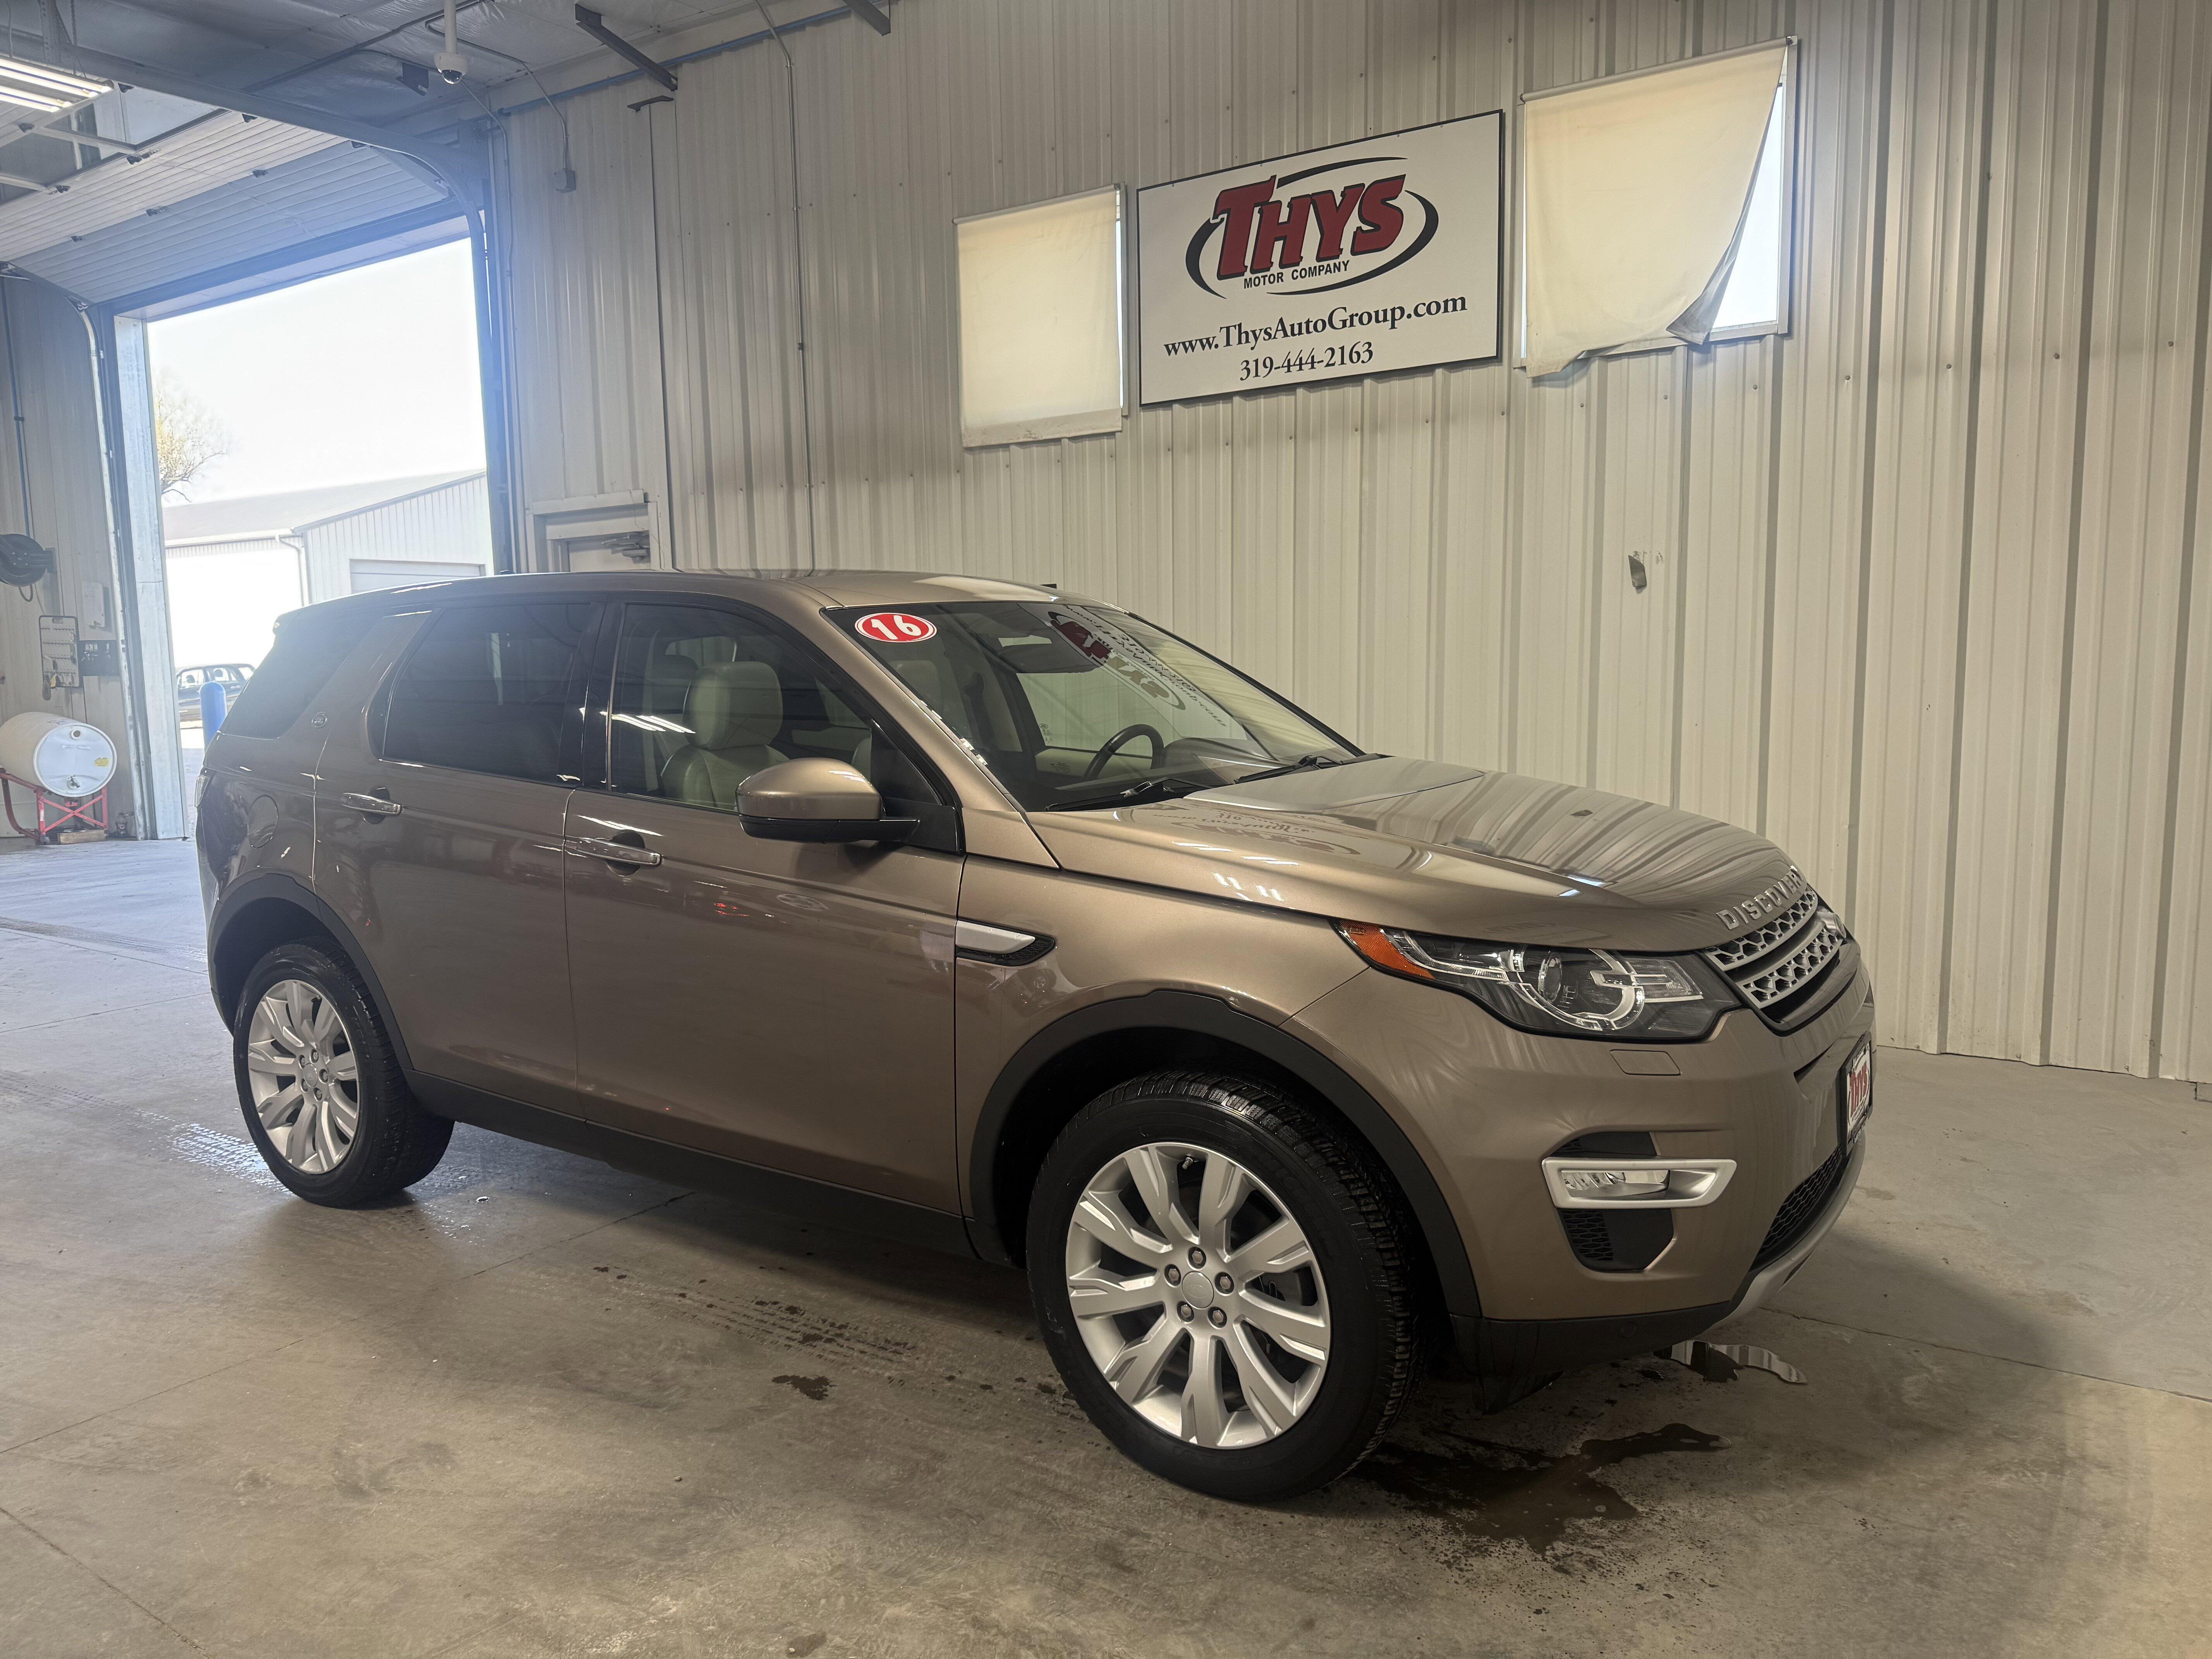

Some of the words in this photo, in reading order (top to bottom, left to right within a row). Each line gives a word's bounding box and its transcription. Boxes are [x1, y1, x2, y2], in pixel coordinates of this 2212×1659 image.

[1213, 174, 1406, 280] THYS
[1244, 271, 1284, 289] MOTOR
[1291, 260, 1350, 280] COMPANY
[1163, 296, 1468, 357] www.ThysAutoGroup.com
[1240, 341, 1374, 381] 319-444-2163
[871, 615, 922, 640] 16
[1849, 1060, 1867, 1119] THYS
